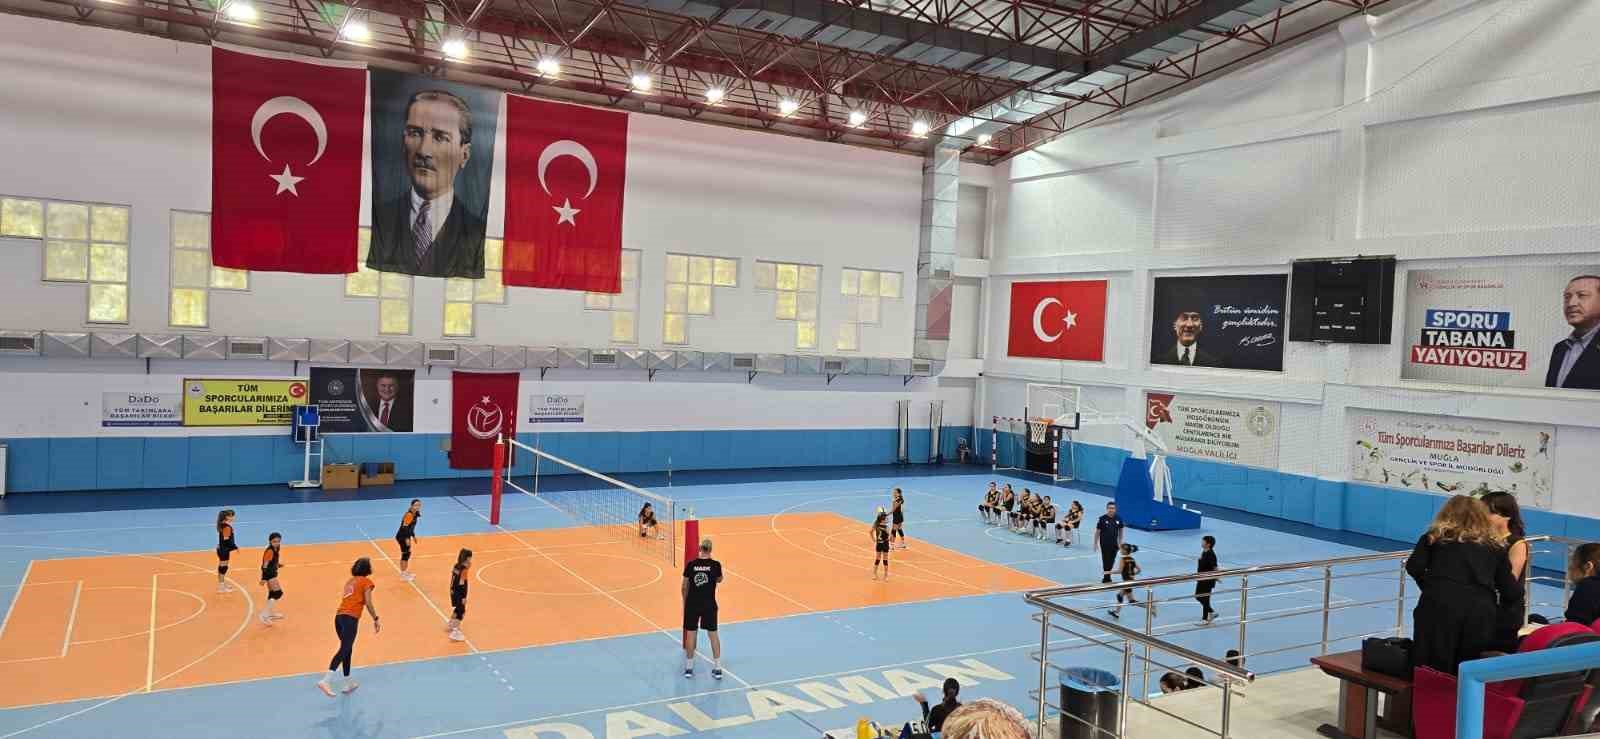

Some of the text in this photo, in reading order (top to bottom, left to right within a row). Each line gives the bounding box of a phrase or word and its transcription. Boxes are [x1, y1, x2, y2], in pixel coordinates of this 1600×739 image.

[1432, 311, 1498, 330] SPORU
[1426, 330, 1506, 348] TABANA
[1415, 347, 1524, 369] YAYIYORUZ
[238, 383, 258, 393] TÜM
[205, 394, 288, 403] SPORCULARIMIZA
[199, 405, 253, 415] BAŞARILAR
[1378, 431, 1526, 459] Tüm Sporcularımıza Başarılar Dileriz
